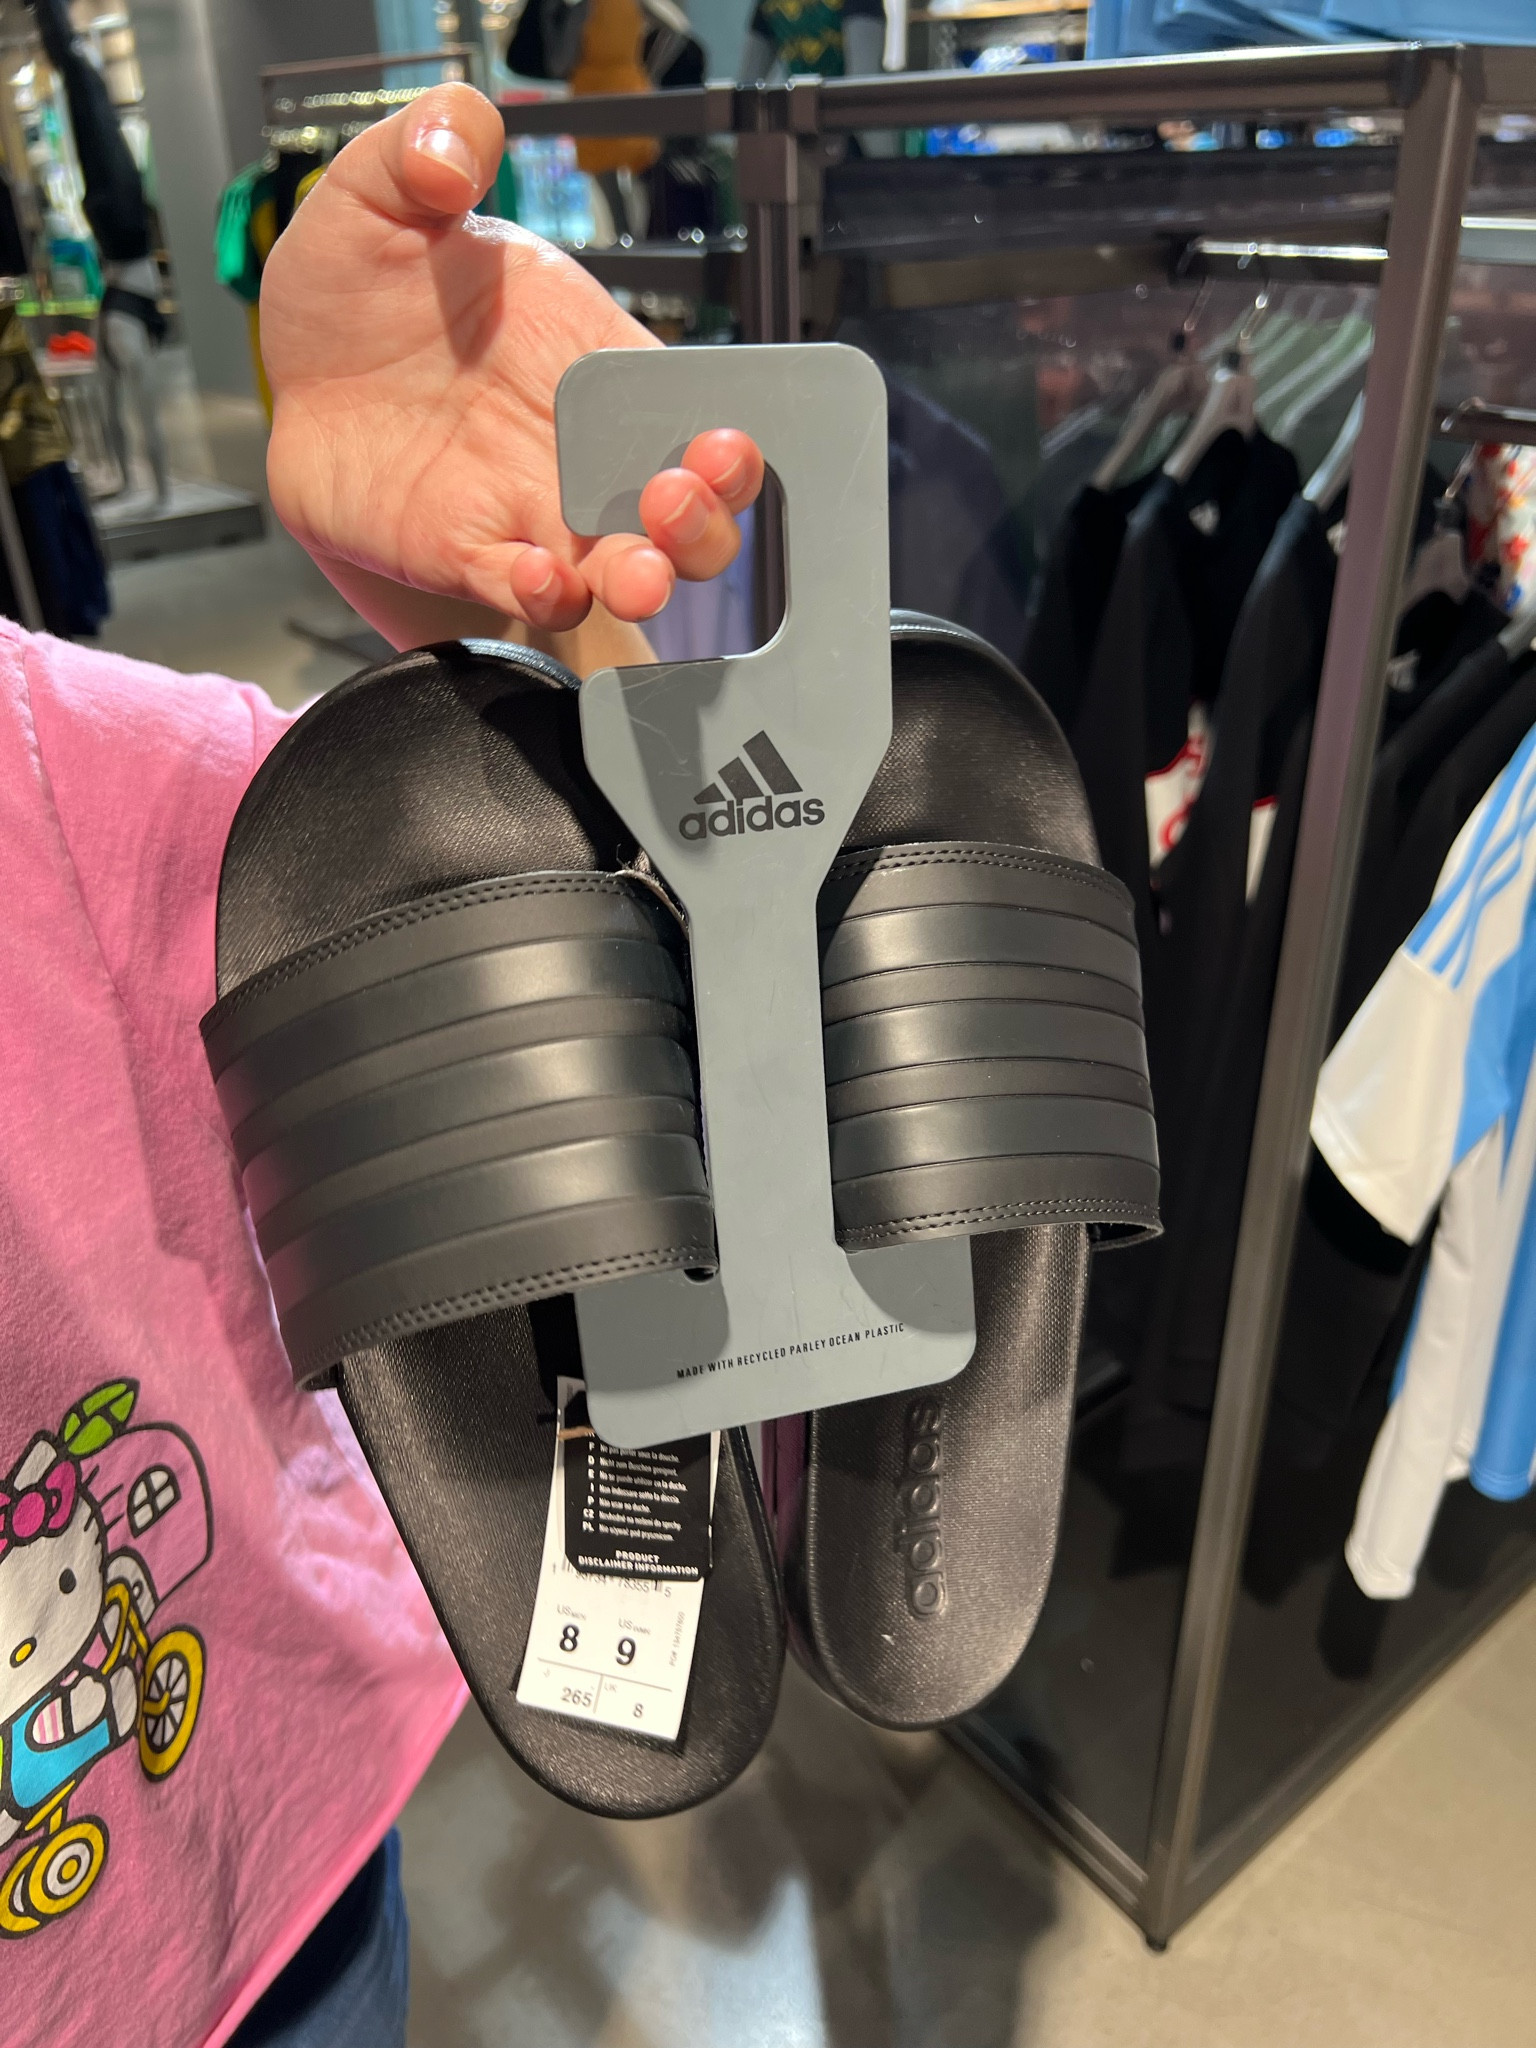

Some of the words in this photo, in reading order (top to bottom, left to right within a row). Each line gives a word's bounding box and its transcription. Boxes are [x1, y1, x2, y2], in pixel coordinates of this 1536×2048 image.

[679, 796, 825, 840] adidas
[677, 1365, 704, 1379] MADE
[708, 1359, 734, 1372] WITH
[737, 1347, 786, 1366] RECYCLED
[790, 1340, 826, 1355] PARLEY
[829, 1332, 860, 1347] OCEAN
[866, 1323, 904, 1339] PLASTIC
[895, 1403, 947, 1619] adidas
[578, 1555, 633, 1570] DISCLAIMER
[635, 1562, 699, 1575] INFORMATION
[616, 1550, 660, 1564] PRODUCT
[559, 1624, 580, 1652] 8
[615, 1637, 636, 1666] 9
[560, 1686, 593, 1708] 265
[632, 1702, 645, 1719] 8
